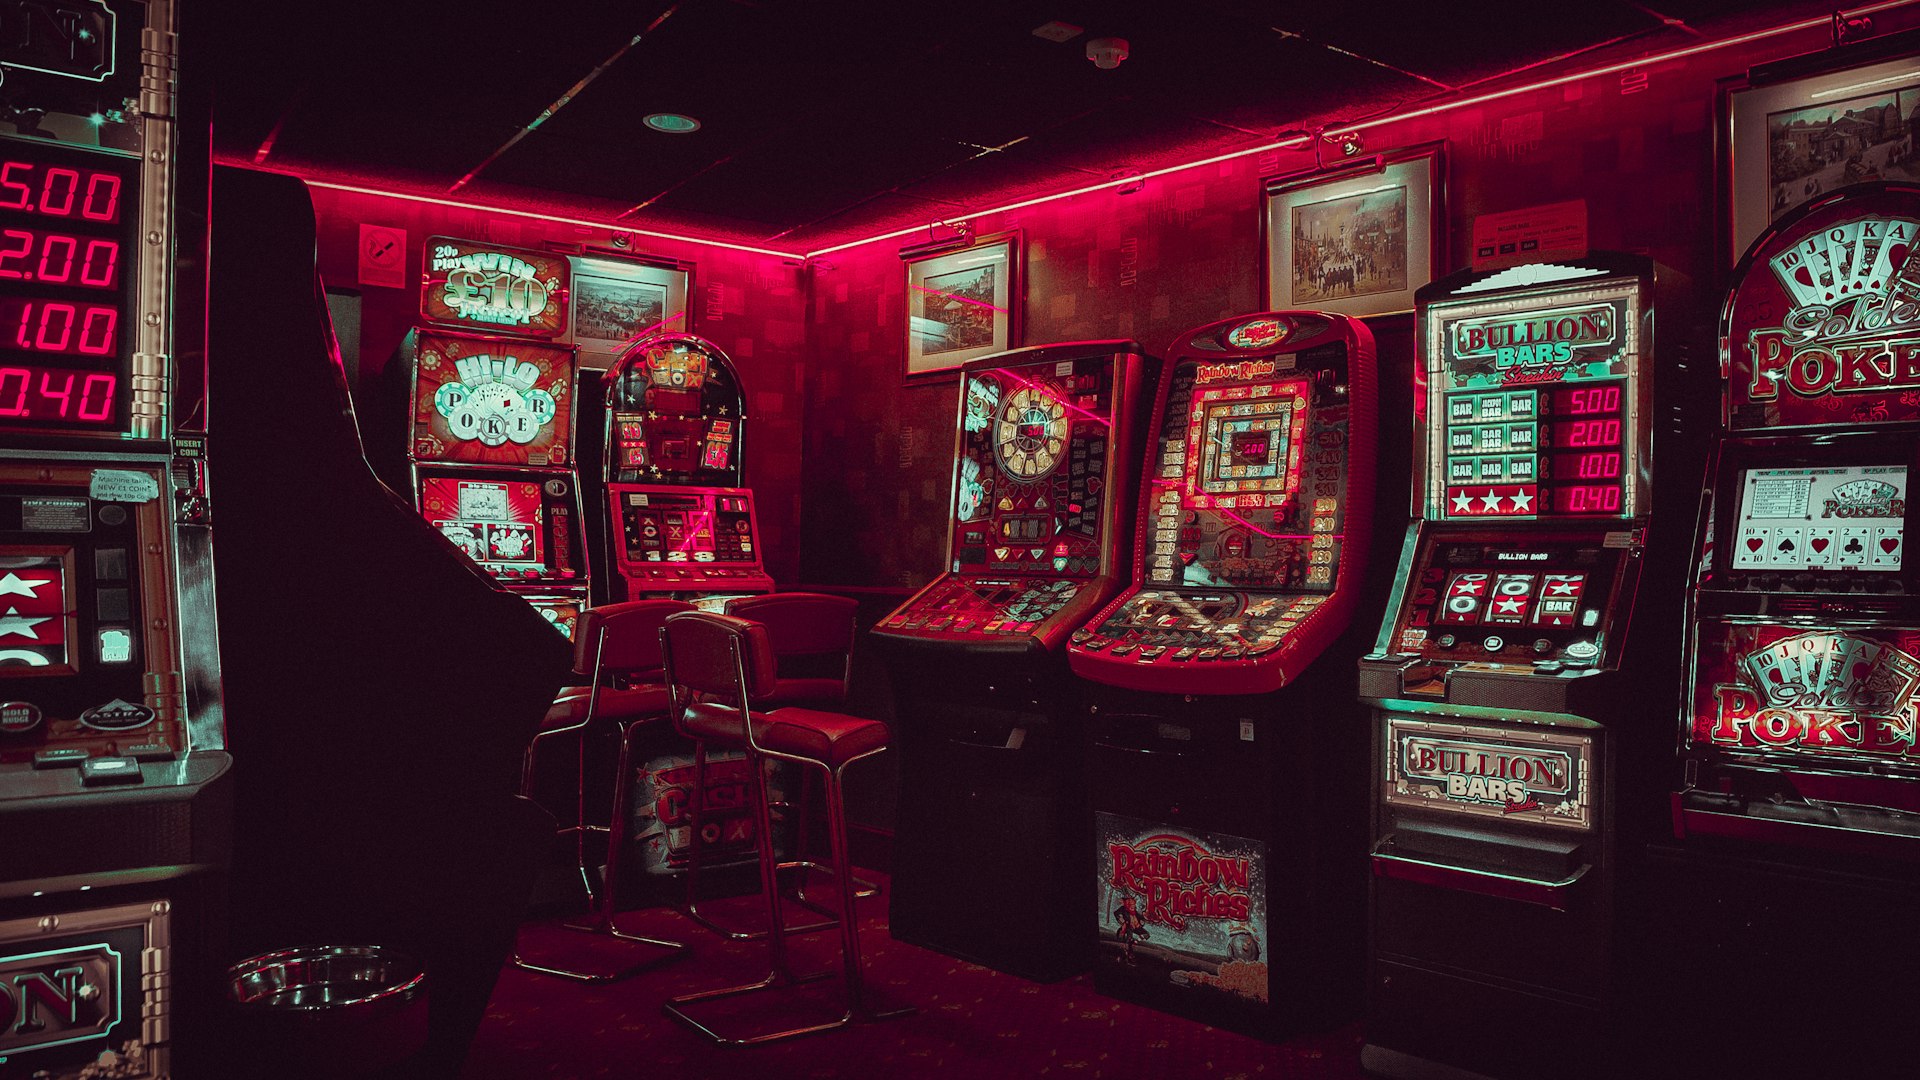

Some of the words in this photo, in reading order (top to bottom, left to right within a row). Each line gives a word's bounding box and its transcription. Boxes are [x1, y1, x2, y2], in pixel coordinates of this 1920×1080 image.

[0, 161, 121, 221] 5.00
[1830, 229, 1845, 243] Q
[1863, 222, 1879, 238] K
[1888, 223, 1906, 239] A
[1806, 239, 1817, 254] J
[0, 230, 119, 287] 2.00
[460, 253, 537, 278] WIN
[1779, 251, 1800, 271] 10
[443, 267, 548, 317] £10
[1783, 285, 1920, 346] Golde
[17, 303, 118, 354] 1.00
[1467, 311, 1603, 350] BULLION
[1497, 341, 1573, 369] BARS
[1196, 362, 1239, 384] Rainbow
[1512, 399, 1531, 412] BAR
[1571, 388, 1620, 414] 5.00
[1453, 404, 1472, 415] BAR
[1482, 408, 1502, 417] BAR
[1453, 434, 1472, 446] BAR
[1482, 430, 1502, 439] BAR
[1512, 431, 1532, 443] BAR
[1570, 419, 1620, 446] 2.00
[175, 439, 202, 448] INSERT
[1482, 439, 1502, 448] BAR
[180, 449, 199, 457] COIN
[1453, 465, 1472, 477] BAR
[1482, 464, 1501, 476] BAR
[1511, 463, 1531, 475] BAR
[1579, 452, 1620, 478] 1.00
[98, 476, 130, 484] Machine
[1569, 487, 1620, 511] 0.40
[1545, 601, 1573, 611] BAR
[1780, 645, 1789, 658] J
[1802, 639, 1815, 652] Q
[1831, 638, 1844, 651] K
[1852, 645, 1868, 659] A
[1755, 654, 1773, 669] 10
[90, 711, 146, 719] ASTRA
[1417, 747, 1557, 786] BULLION
[1448, 773, 1526, 803] BARS
[1108, 842, 1249, 893] Rainbow
[1143, 877, 1251, 931] Riches
